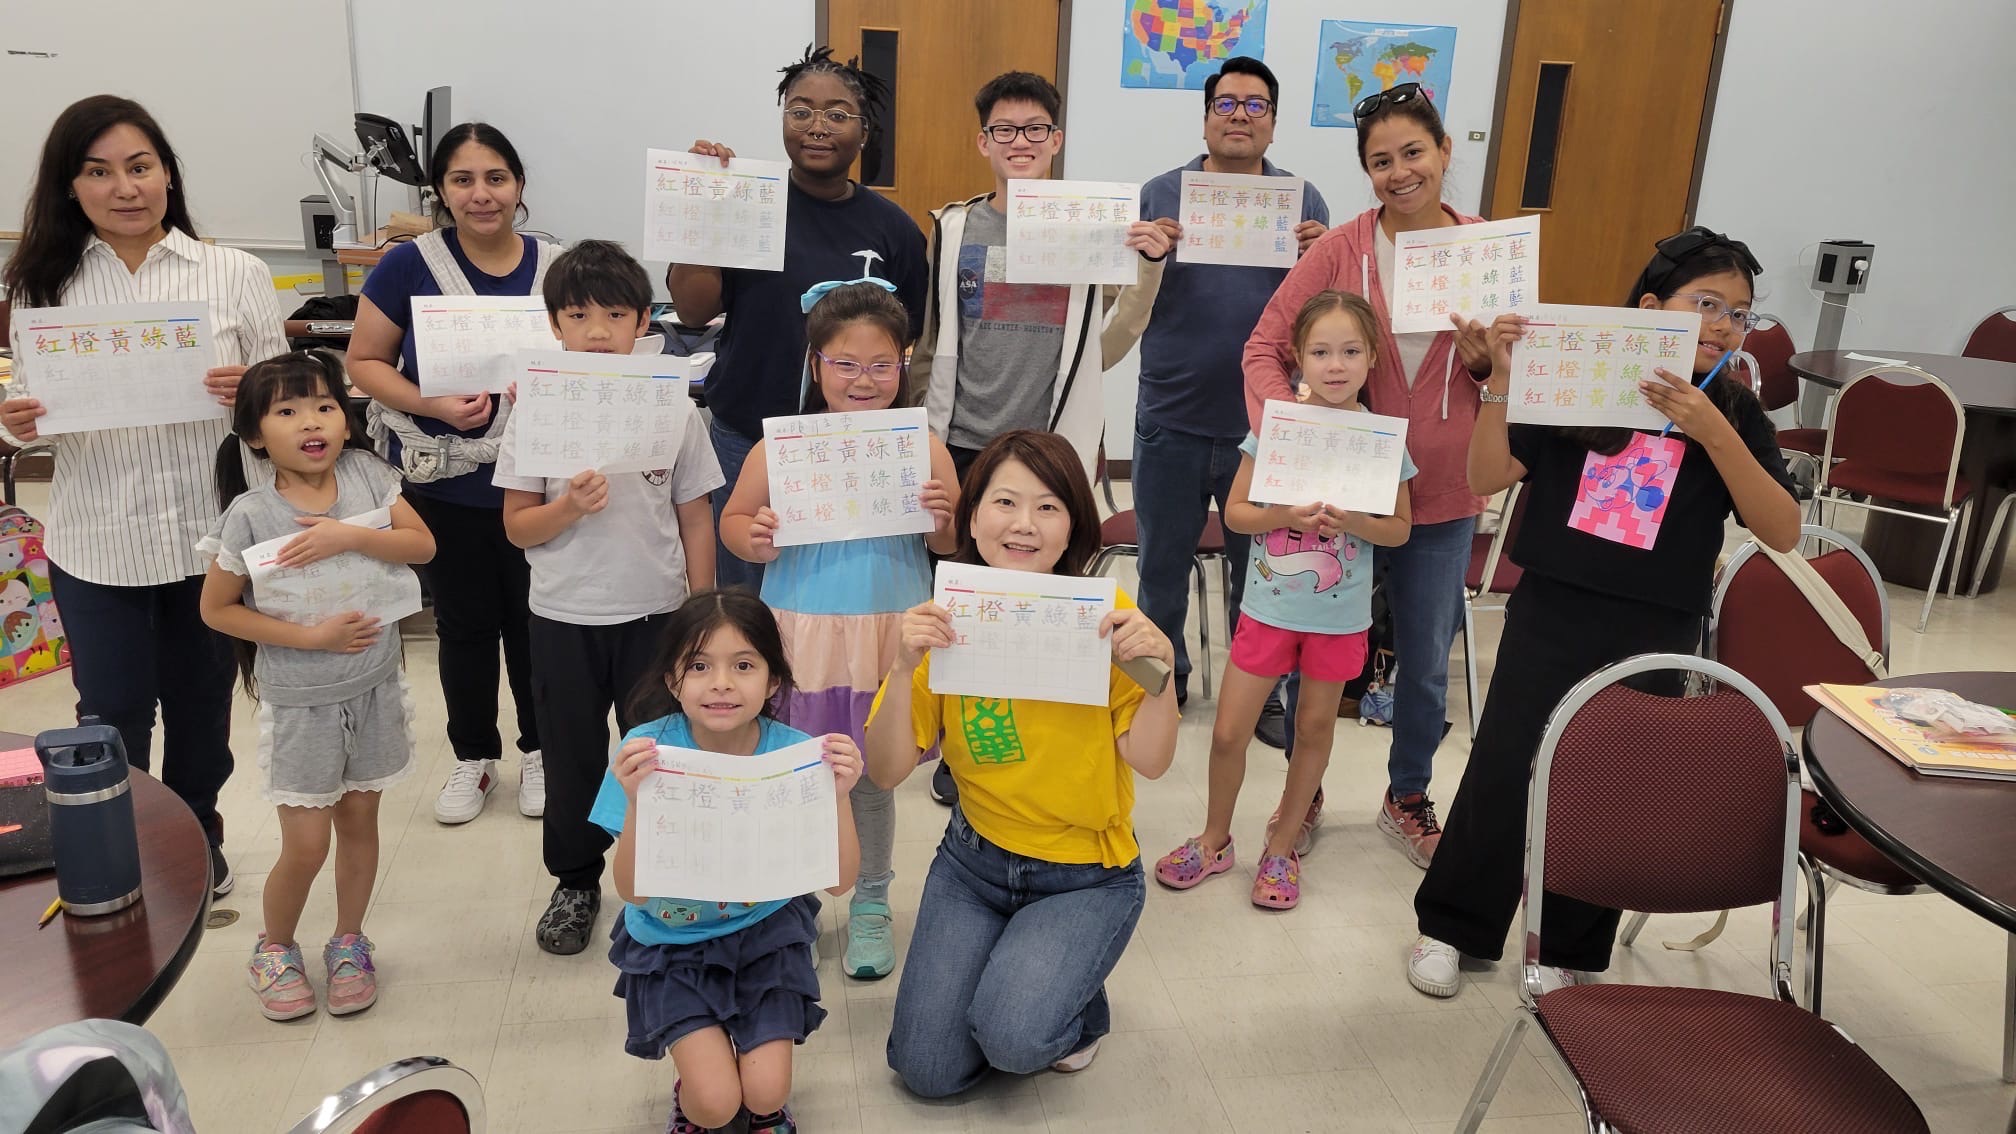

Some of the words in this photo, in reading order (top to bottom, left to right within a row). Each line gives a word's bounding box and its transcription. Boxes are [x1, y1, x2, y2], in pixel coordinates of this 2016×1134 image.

[656, 173, 776, 204] 紅橙黃綠藍
[1188, 189, 1292, 210] 紅橙黃綠藍
[1016, 201, 1129, 222] 紅橙黃綠藍
[1404, 239, 1527, 270] 紅橙黃綠藍
[34, 324, 200, 355] 紅橙黃綠藍
[1525, 329, 1681, 359] 紅橙黃綠藍
[1526, 359, 1665, 382] 紅橙黃綠
[529, 376, 675, 407] 紅橙黃綠藍
[777, 434, 917, 466] 紅橙黃綠藍
[1269, 423, 1393, 460] 紅橙黃綠藍
[783, 466, 918, 496] 紅橙黃綠藍
[652, 770, 824, 815] 紅橙黃綠藍
